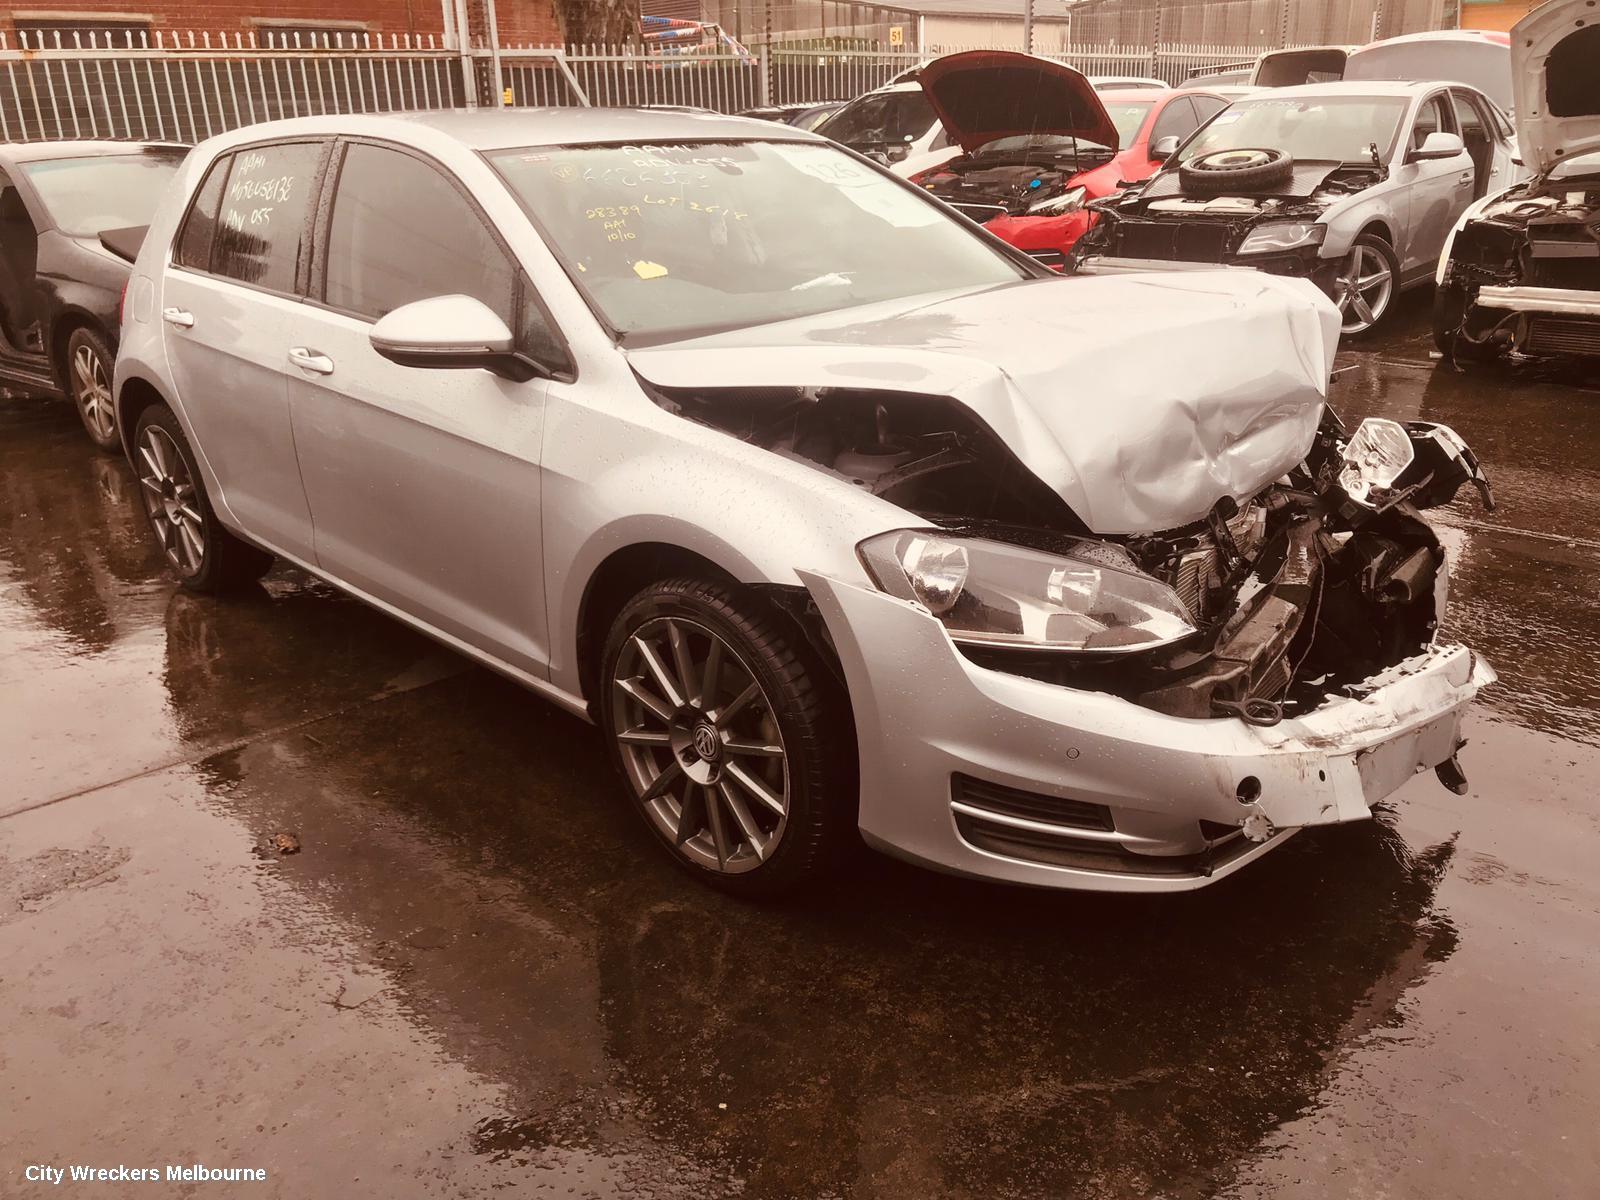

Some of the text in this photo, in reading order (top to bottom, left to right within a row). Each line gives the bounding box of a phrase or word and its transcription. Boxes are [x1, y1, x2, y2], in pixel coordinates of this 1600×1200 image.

[891, 31, 901, 42] 51
[621, 145, 693, 156] AAMI
[643, 194, 681, 207] LOT
[585, 205, 643, 220] 28389
[607, 229, 637, 243] 10/10
